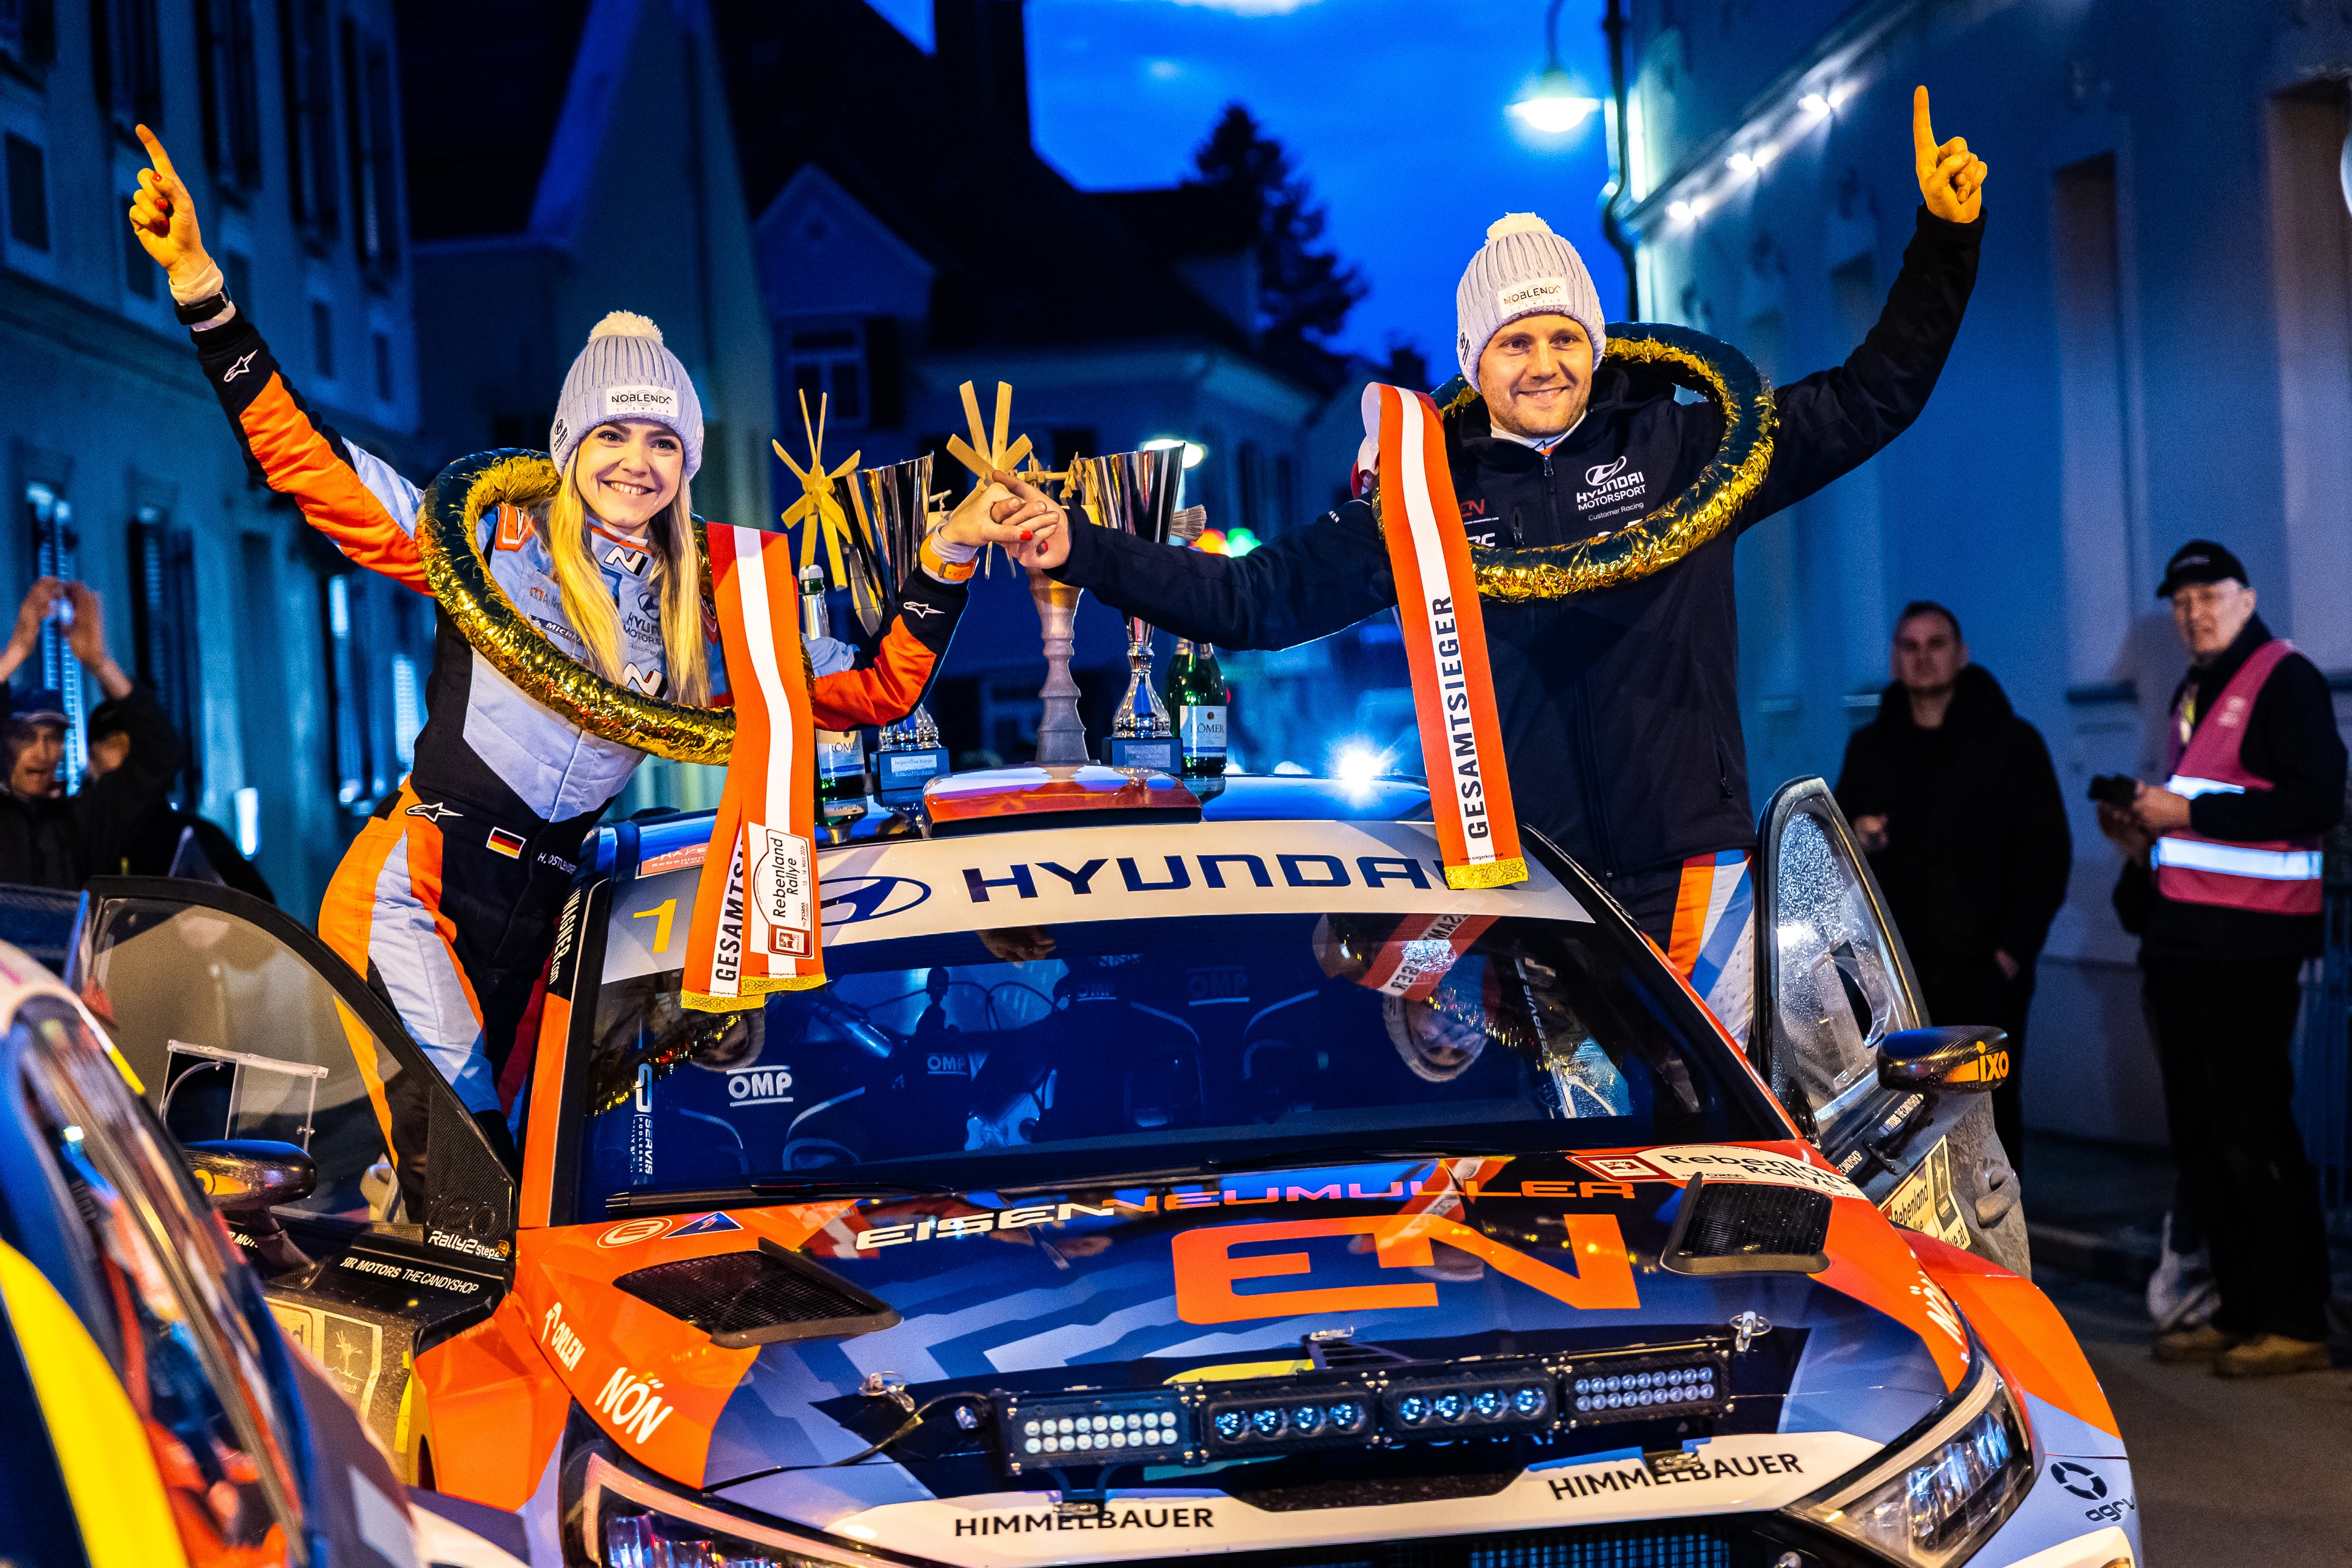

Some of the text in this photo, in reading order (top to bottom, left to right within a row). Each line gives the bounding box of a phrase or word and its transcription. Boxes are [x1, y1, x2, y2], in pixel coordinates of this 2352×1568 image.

[1576, 471, 1645, 503] HYUNDAI
[1578, 484, 1646, 511] MOTORSPORT
[1588, 502, 1644, 521] Customer Racing
[1433, 596, 1489, 839] GESAMTSIEGER
[537, 852, 547, 864] H.
[786, 858, 800, 895] Rallye
[770, 837, 786, 918] Rebenland
[633, 898, 677, 954] 1
[715, 838, 743, 981] GESAMTS
[1976, 1041, 2009, 1082] ixo
[728, 1070, 793, 1100] OMP
[644, 1118, 653, 1175] SERVIS
[1740, 1164, 1843, 1190] Rallye
[427, 1230, 478, 1254] Rally2
[355, 1260, 402, 1278] MOTORS
[402, 1268, 424, 1282] THE
[420, 1273, 479, 1294] CANDYSHOP
[1171, 1213, 1641, 1325] EN
[551, 1321, 586, 1372] ORLEN
[1548, 1453, 1804, 1500] HIMMELBAUER
[955, 1507, 1214, 1536] HIMMELBAUER
